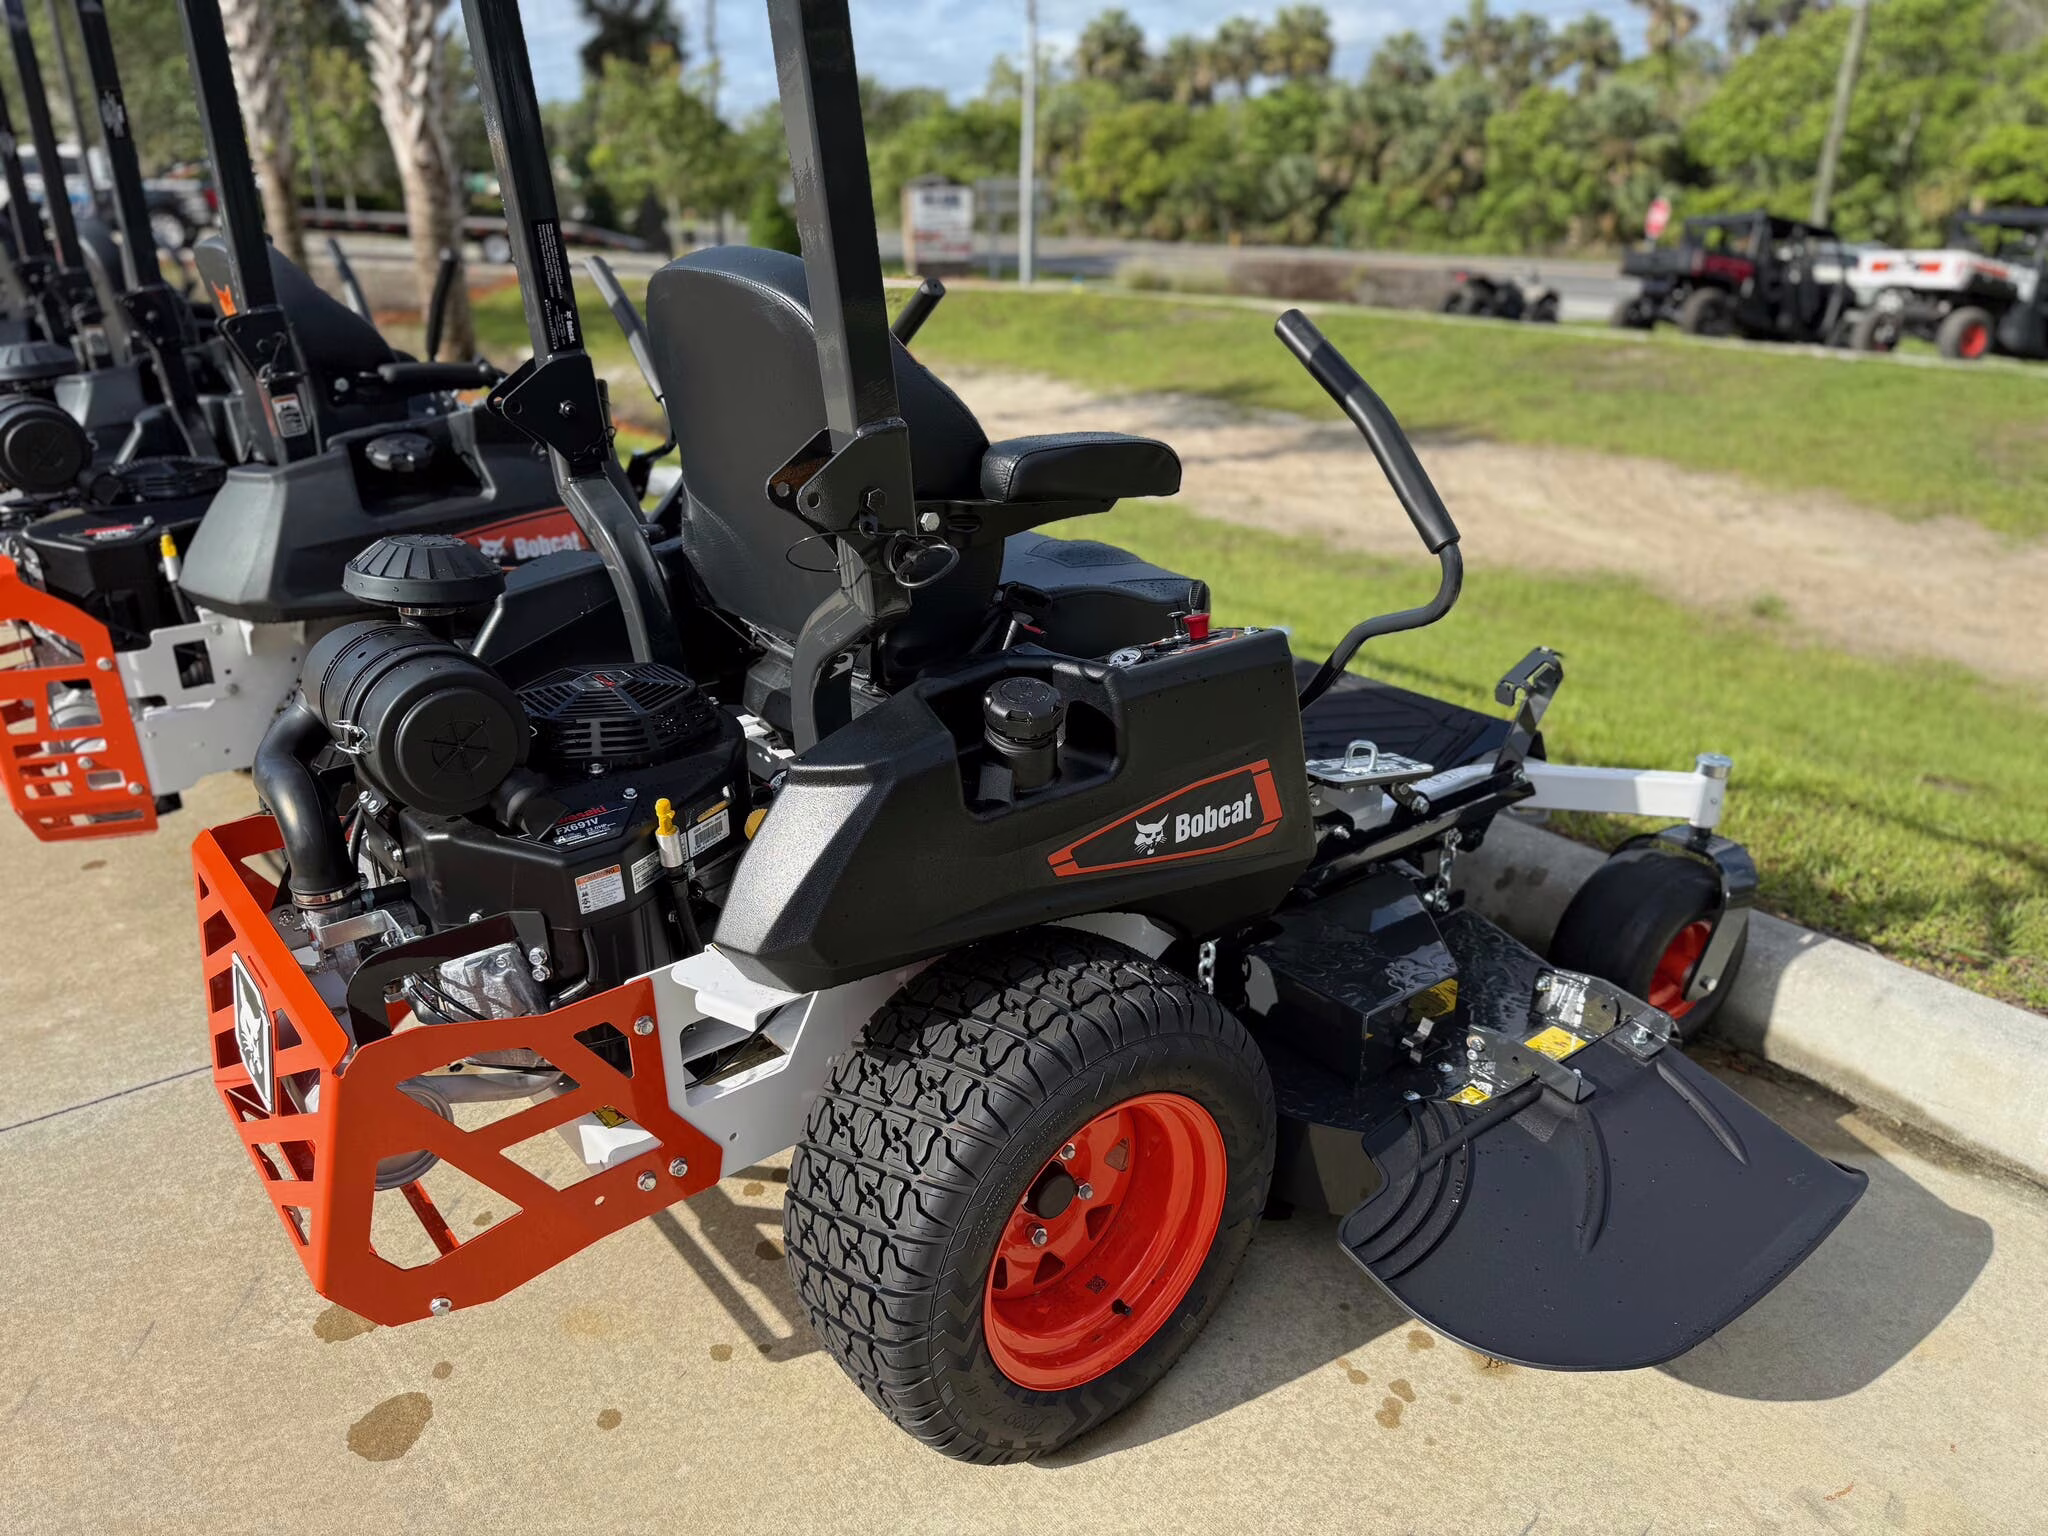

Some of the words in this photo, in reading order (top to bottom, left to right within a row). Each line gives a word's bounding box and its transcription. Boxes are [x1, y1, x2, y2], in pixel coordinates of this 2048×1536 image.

[512, 531, 581, 560] Bobcat
[555, 817, 599, 835] FX691V
[1175, 792, 1253, 843] Bobcat
